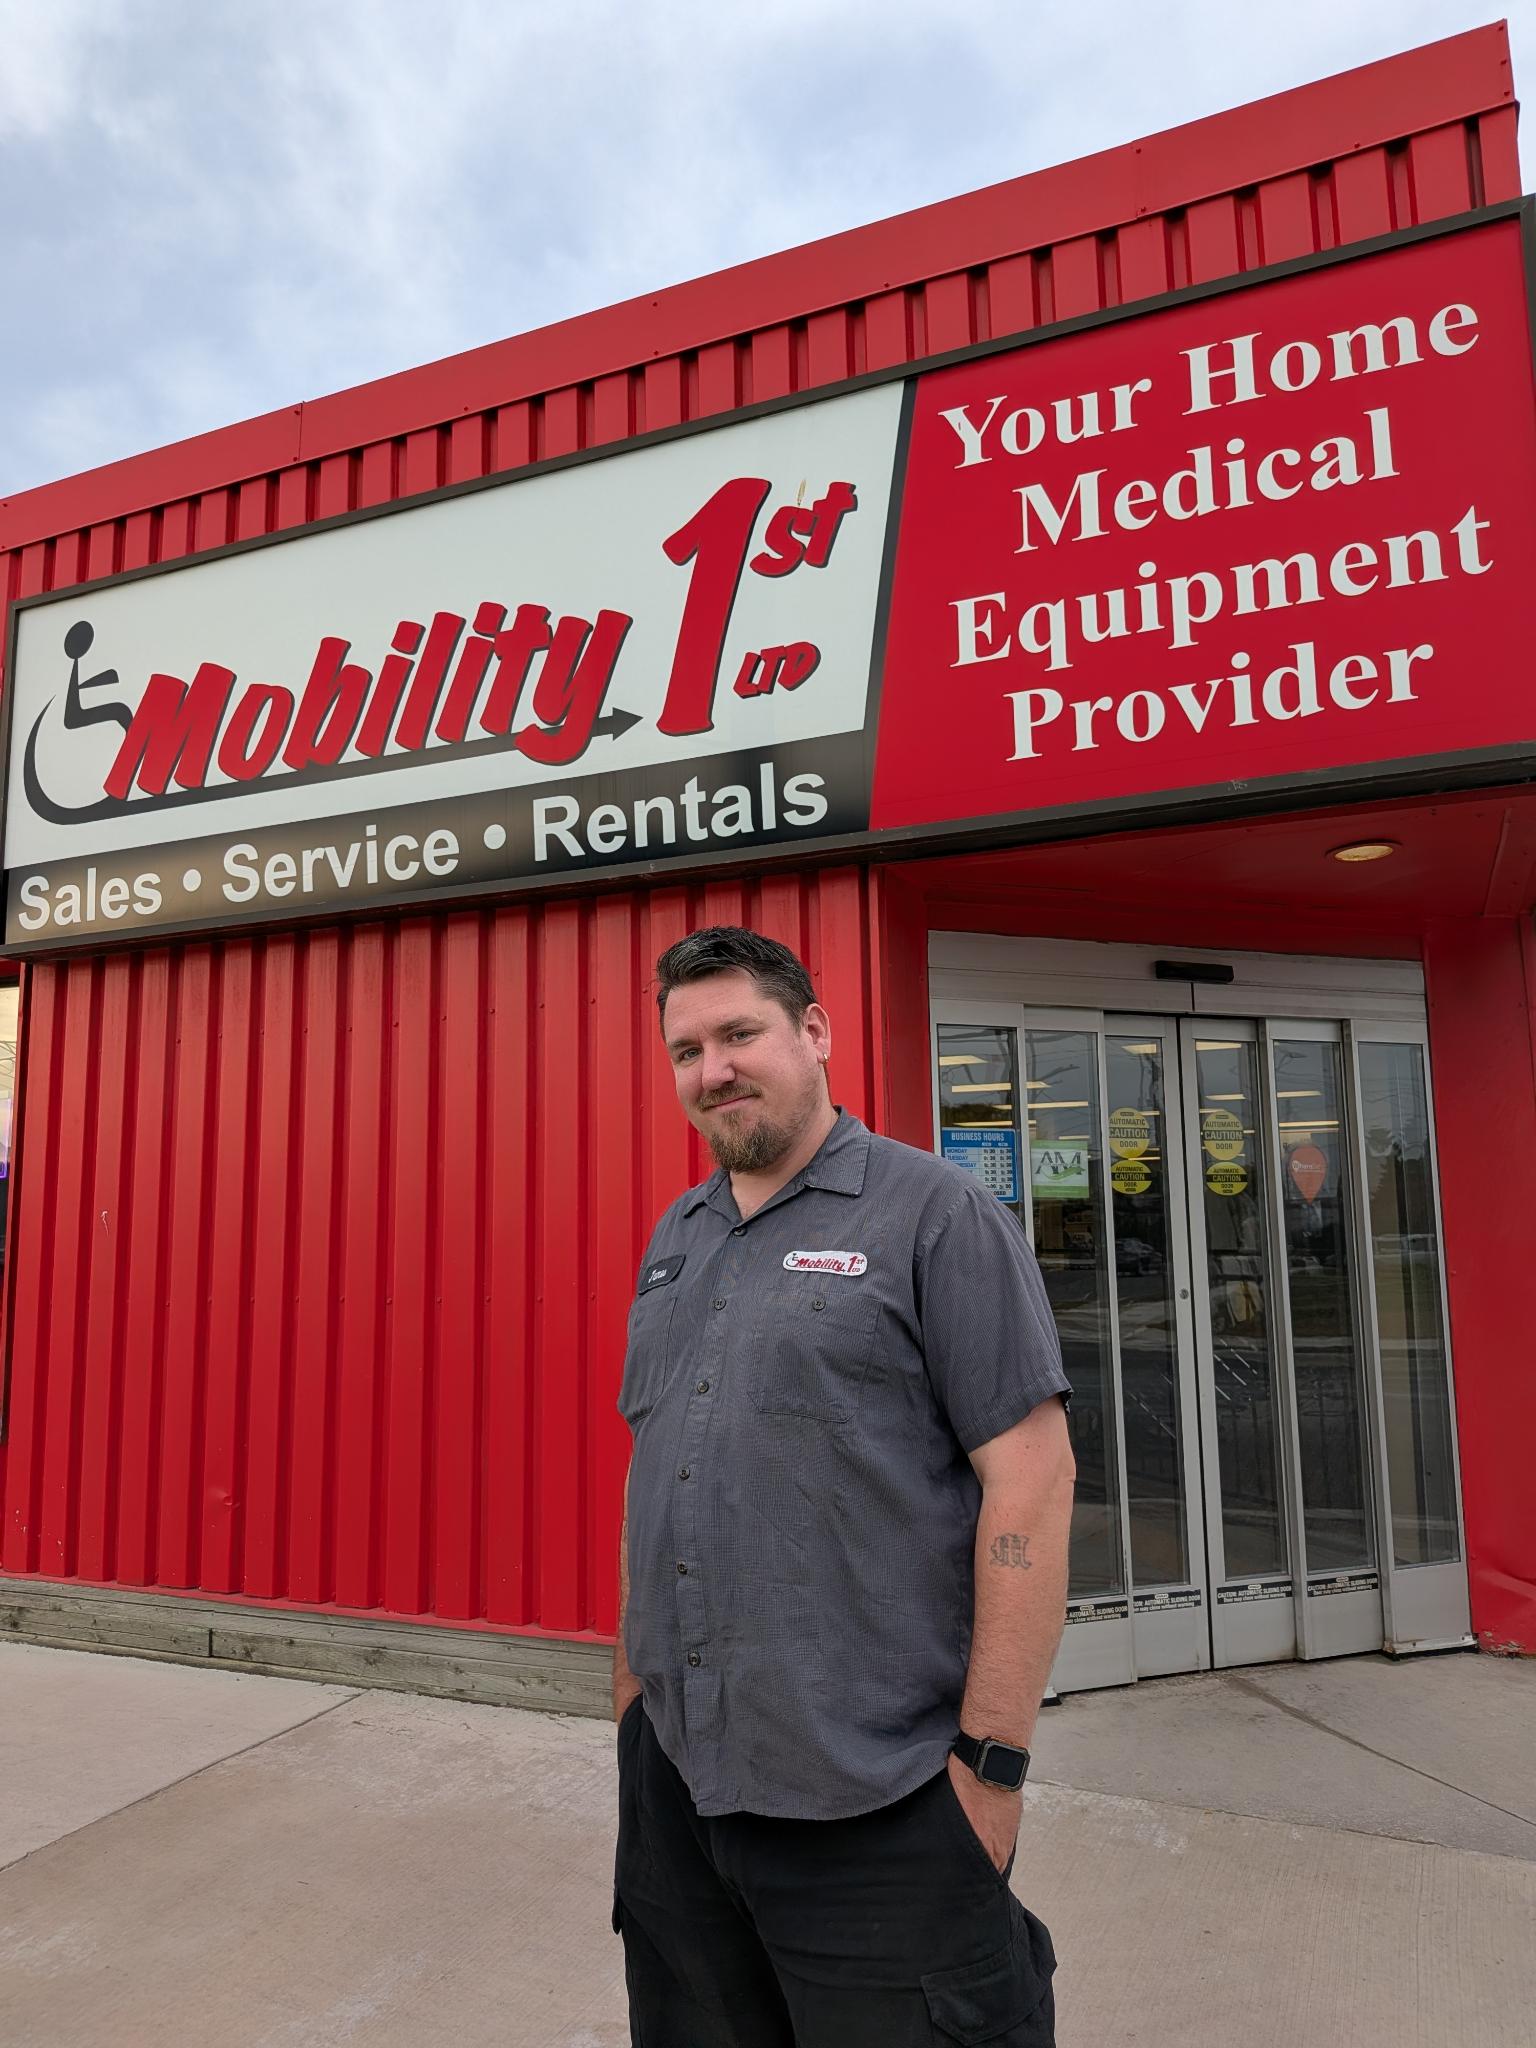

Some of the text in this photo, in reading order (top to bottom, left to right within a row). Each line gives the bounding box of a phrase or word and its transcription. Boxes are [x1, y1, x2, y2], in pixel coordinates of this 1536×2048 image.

[939, 303, 1480, 469] Your Home
[1012, 407, 1400, 554] Medical
[103, 477, 857, 800] Mobility 1st
[948, 505, 1494, 672] Equipment
[733, 641, 821, 699] LTD
[1004, 641, 1434, 761] Provider
[18, 761, 829, 931] Sales Service Rentals
[951, 1132, 1005, 1142] BUSINESS HOURS
[1108, 1128, 1148, 1137] CAUTION
[1204, 1131, 1242, 1140] CAUTION
[796, 1257, 845, 1273] Mobility
